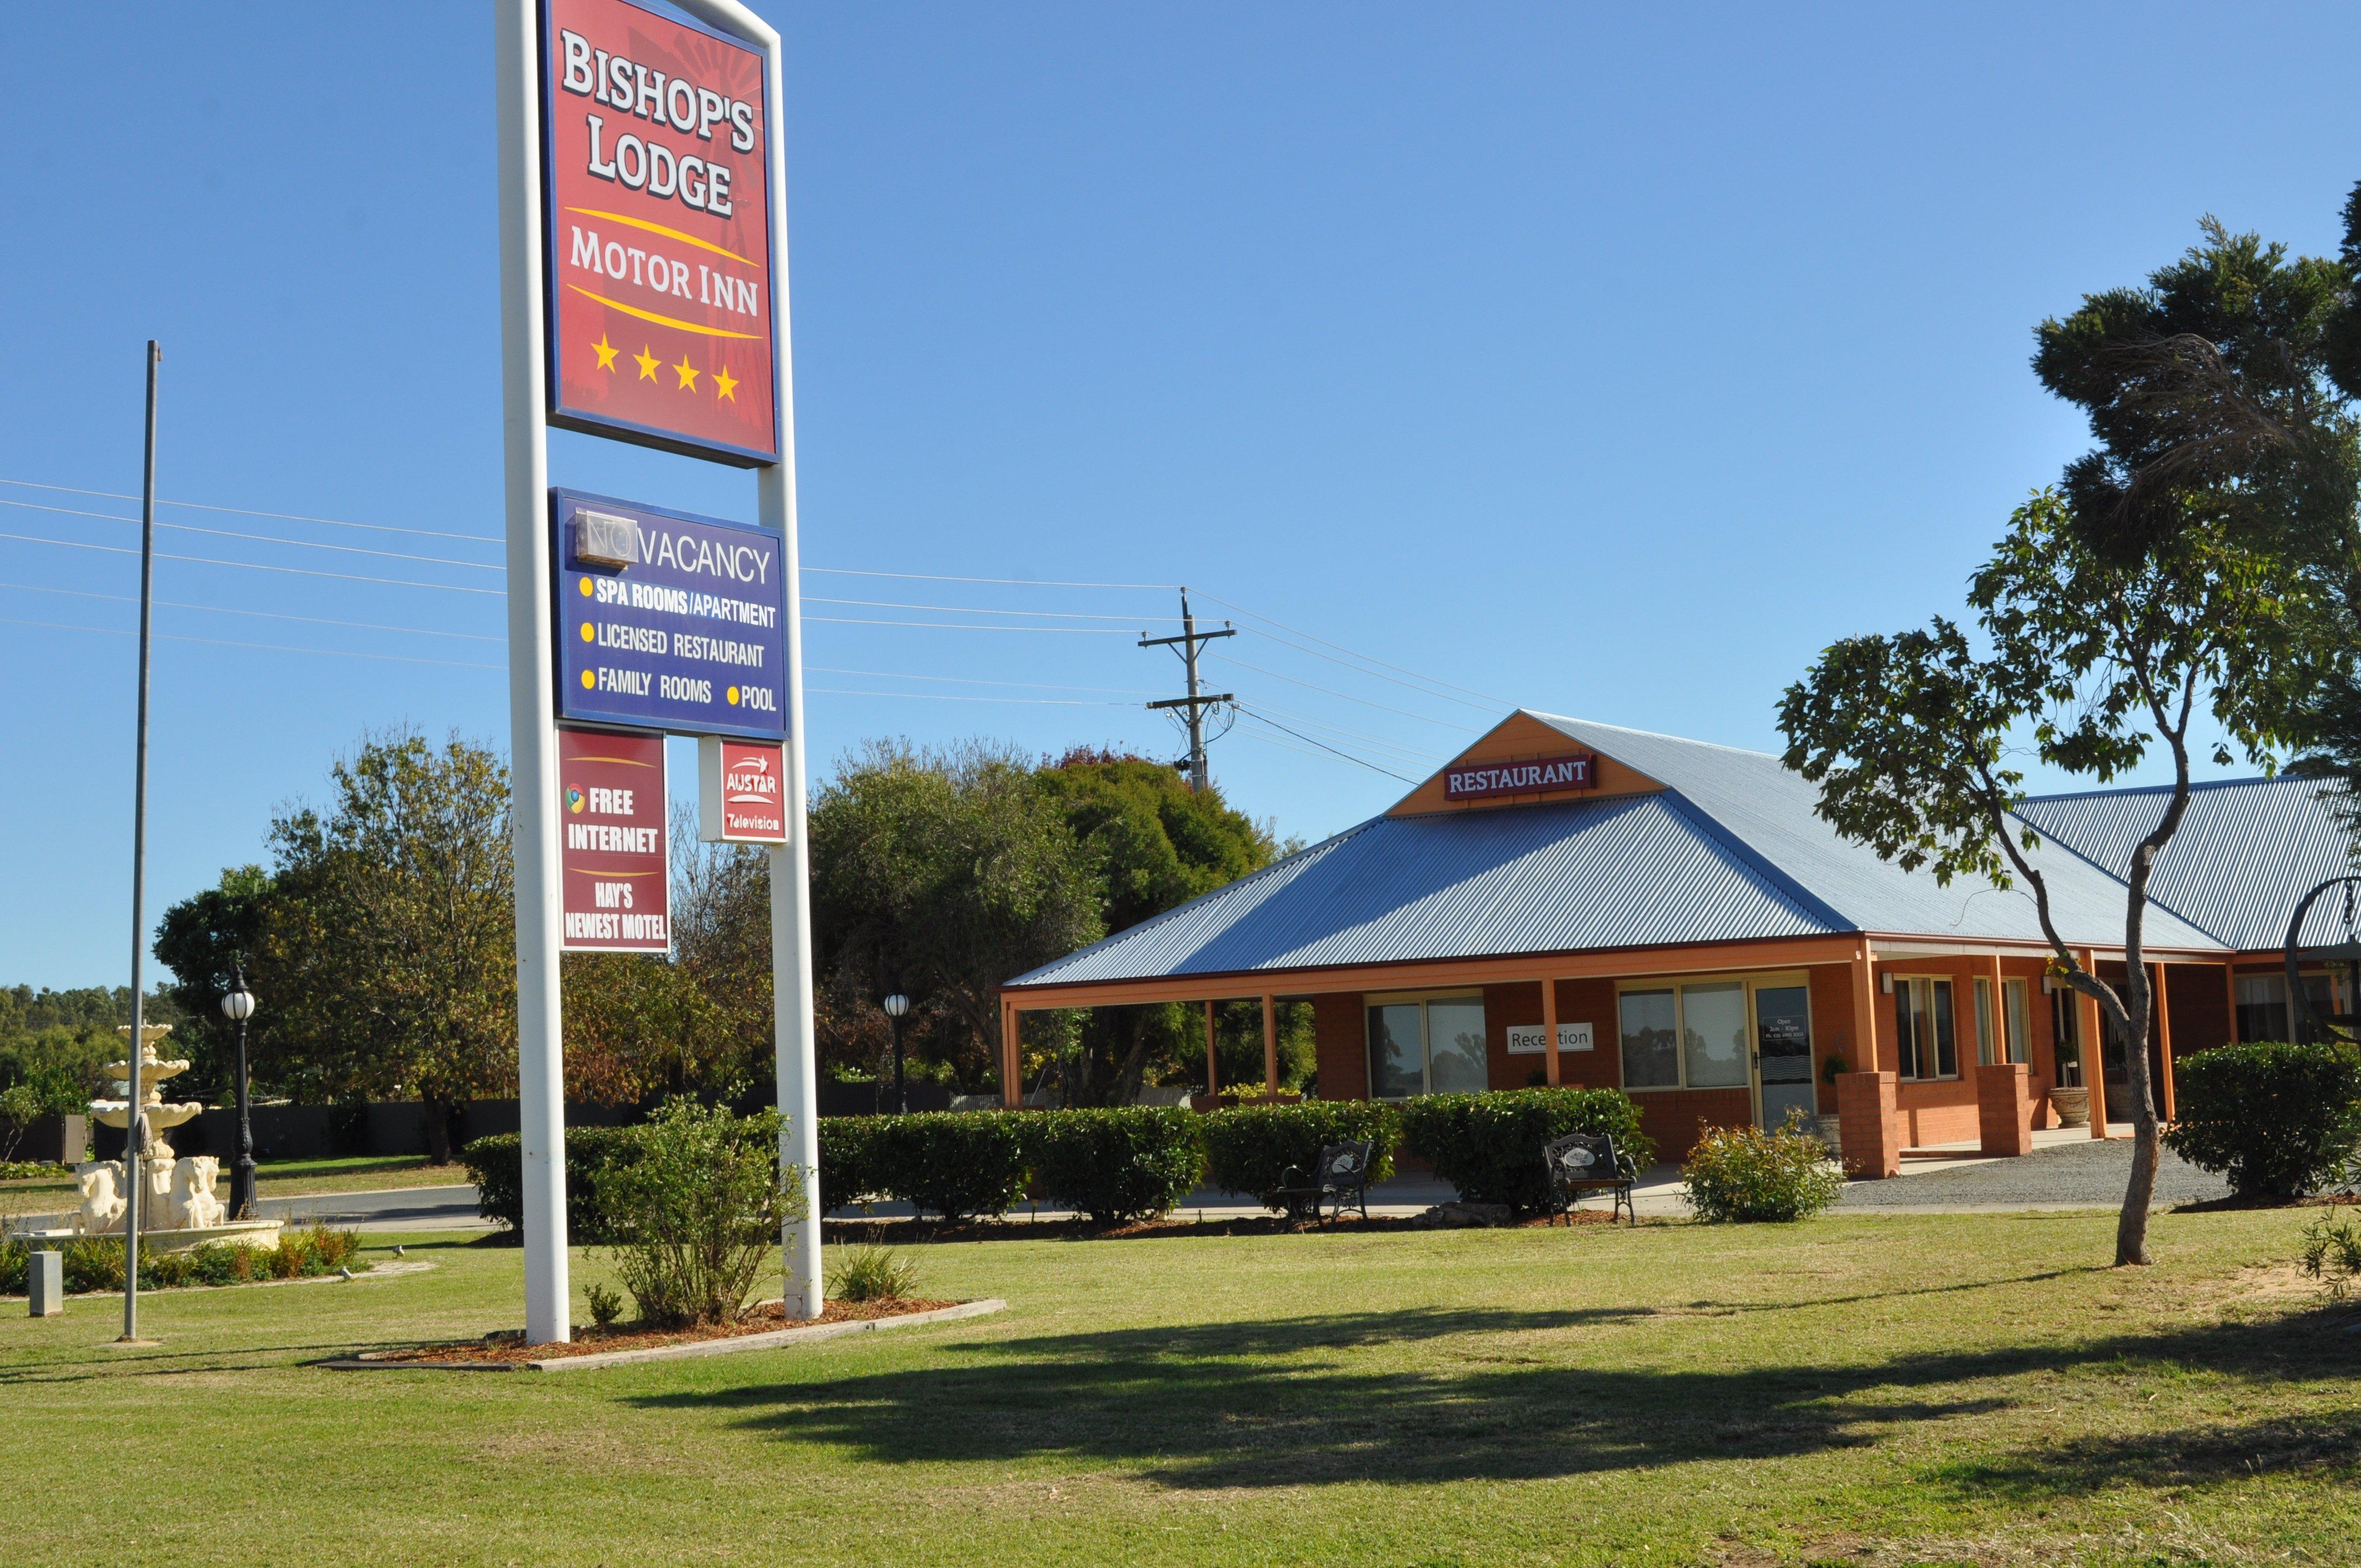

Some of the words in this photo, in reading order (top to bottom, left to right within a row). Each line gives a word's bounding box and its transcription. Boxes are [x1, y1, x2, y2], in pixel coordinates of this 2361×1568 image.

[561, 29, 754, 154] BISHOP'S
[586, 113, 732, 219] LODGE
[570, 226, 693, 301] MOTOR
[700, 264, 758, 318] INN
[587, 519, 632, 557] NO
[638, 527, 770, 584] VACANCY
[596, 578, 628, 606] SPA
[598, 622, 667, 654] LICENSED
[674, 634, 764, 668] RESTAURANT
[598, 667, 651, 696] FAMILY
[661, 675, 711, 703] ROOMS
[742, 685, 776, 711] POOL
[726, 773, 777, 794] AUSTAR
[1449, 761, 1586, 793] RESTAURANT
[590, 788, 634, 815] FREE
[727, 814, 779, 831] Television
[568, 824, 658, 853] INTERNET
[595, 882, 633, 908] HAY'S
[565, 912, 619, 939] NEWEST
[622, 913, 666, 940] MOTEL
[1512, 1030, 1587, 1047] Recetion
